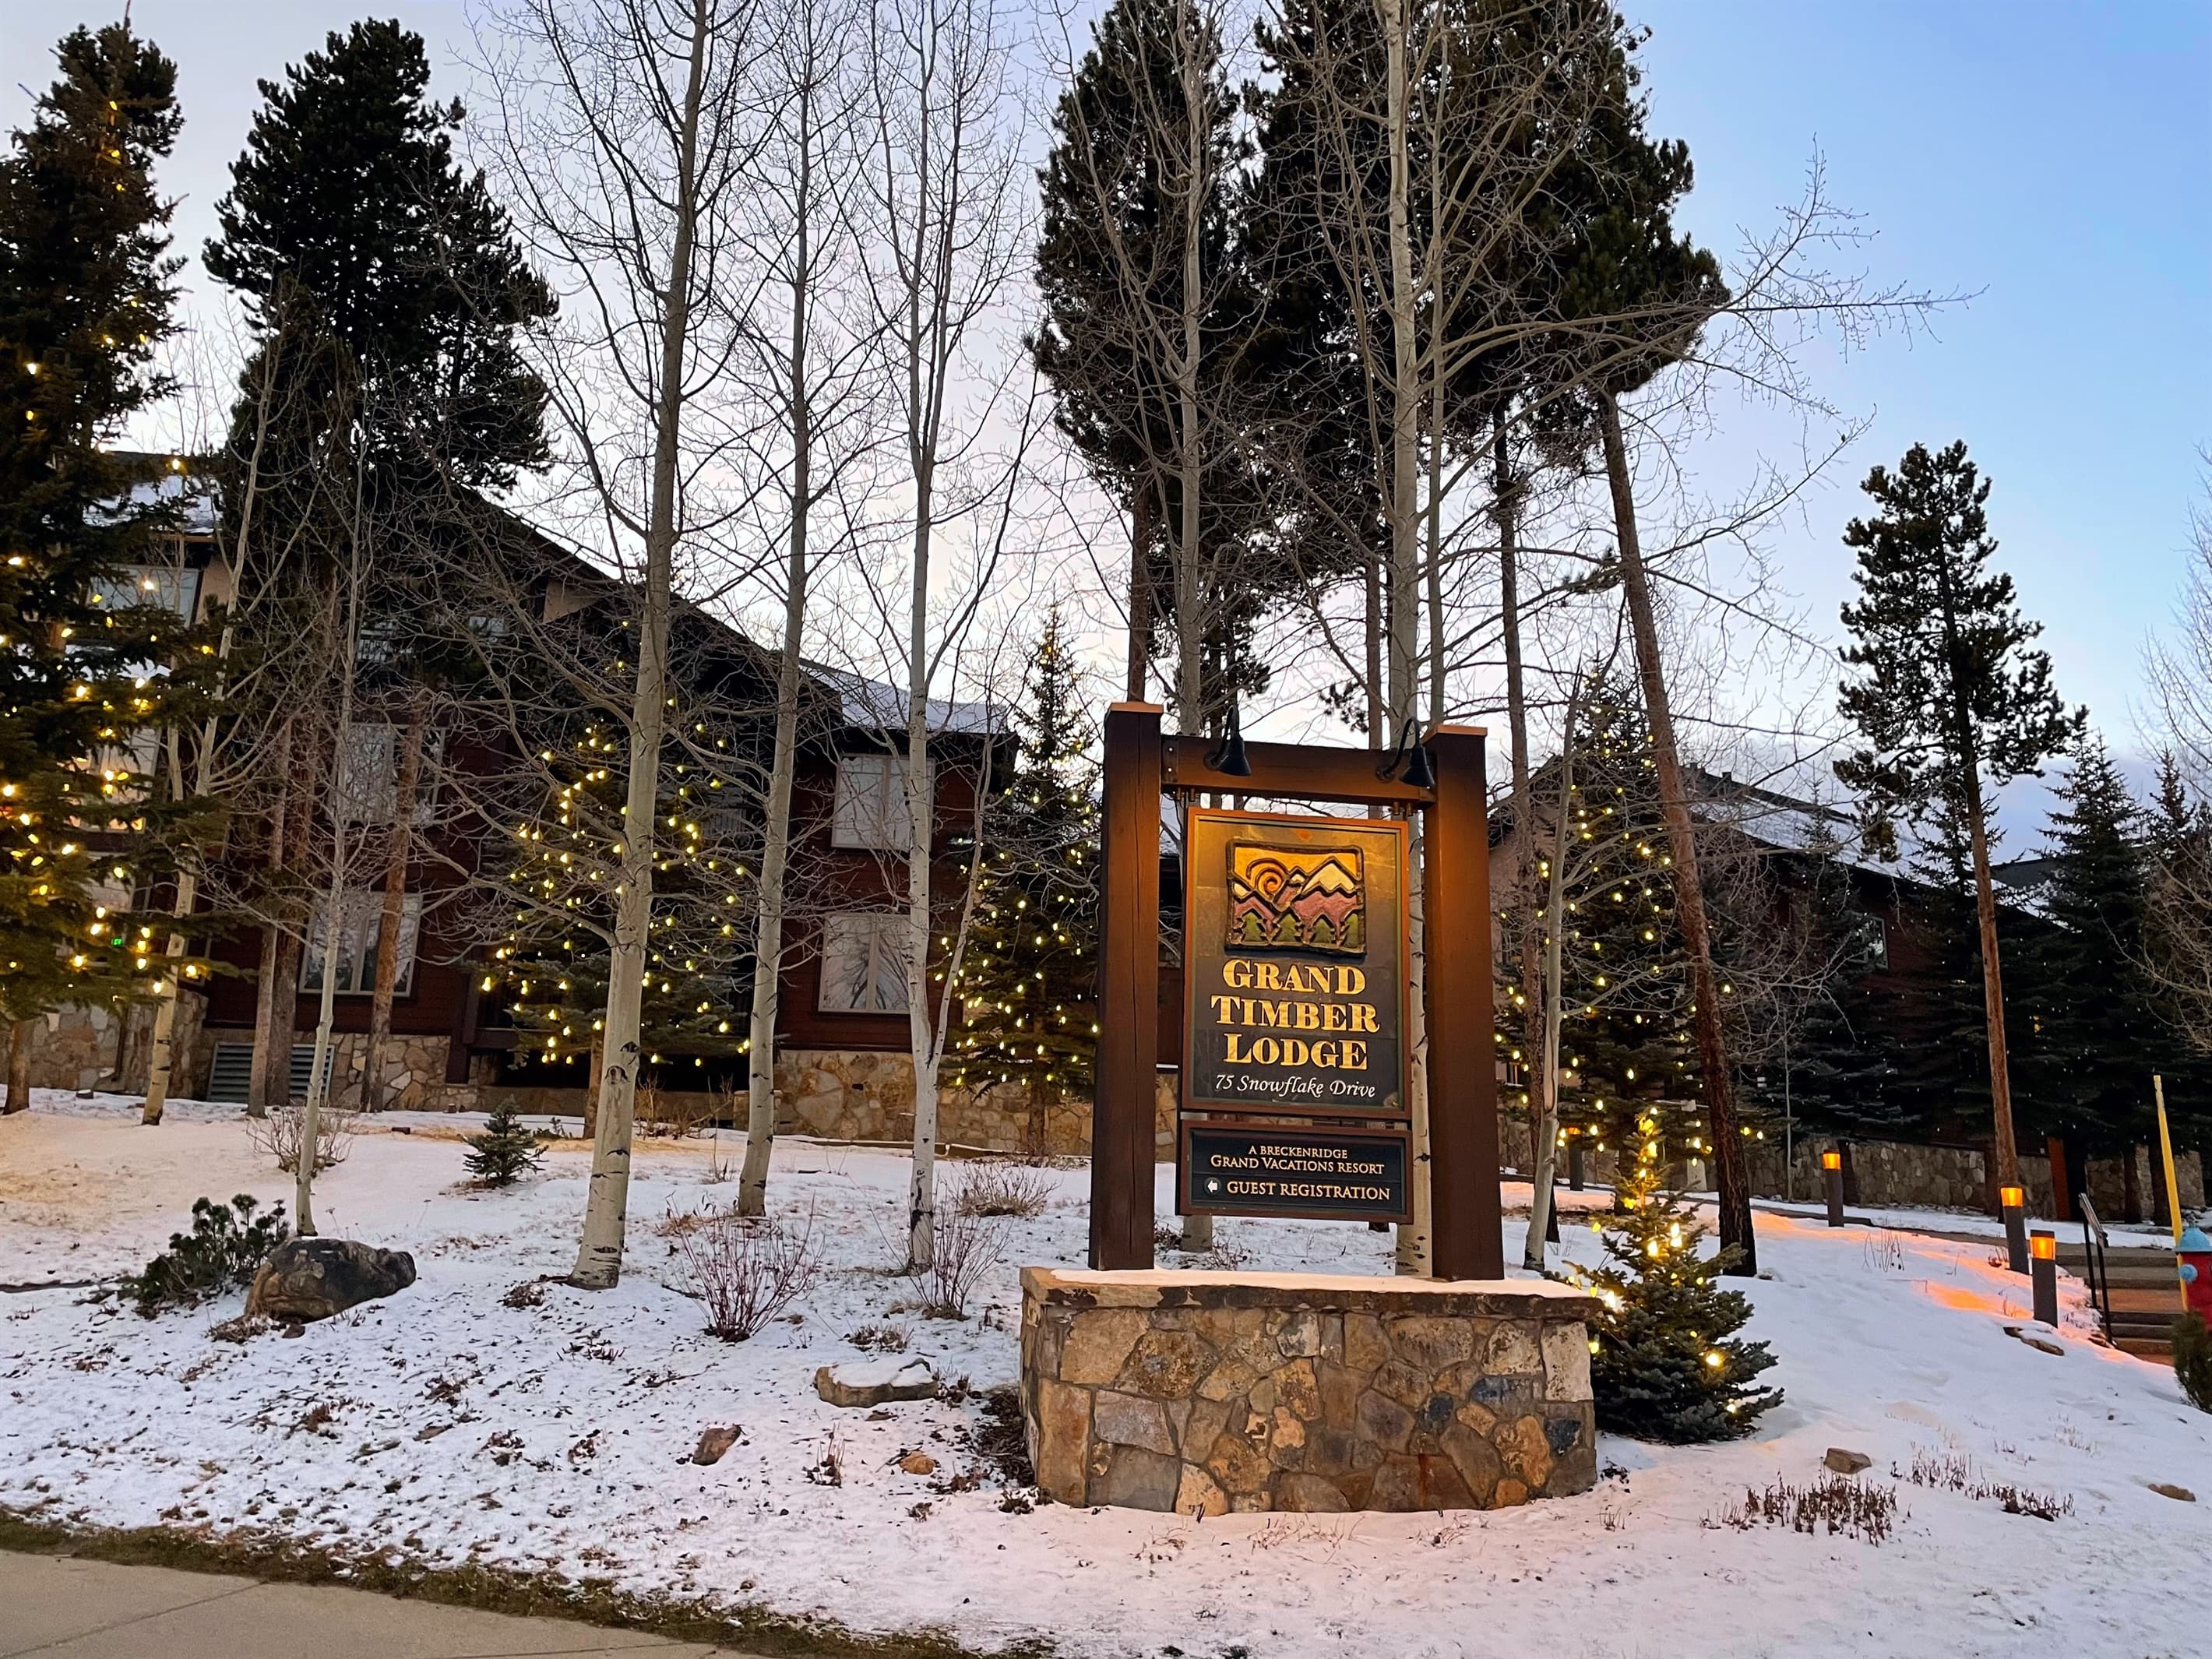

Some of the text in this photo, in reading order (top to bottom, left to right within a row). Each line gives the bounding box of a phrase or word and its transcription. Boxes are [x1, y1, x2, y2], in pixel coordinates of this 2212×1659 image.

[1223, 959, 1365, 995] GRAND
[1210, 995, 1380, 1033] TIMBER
[1223, 1033, 1368, 1069] LODGE
[1215, 1074, 1375, 1097] 75 Snowflake Drive
[1249, 1145, 1348, 1159] A BRECKENRIDGE
[1210, 1154, 1385, 1175] GRAND VACATIONS RESORT
[1227, 1181, 1390, 1200] GUEST REGISTRATION
